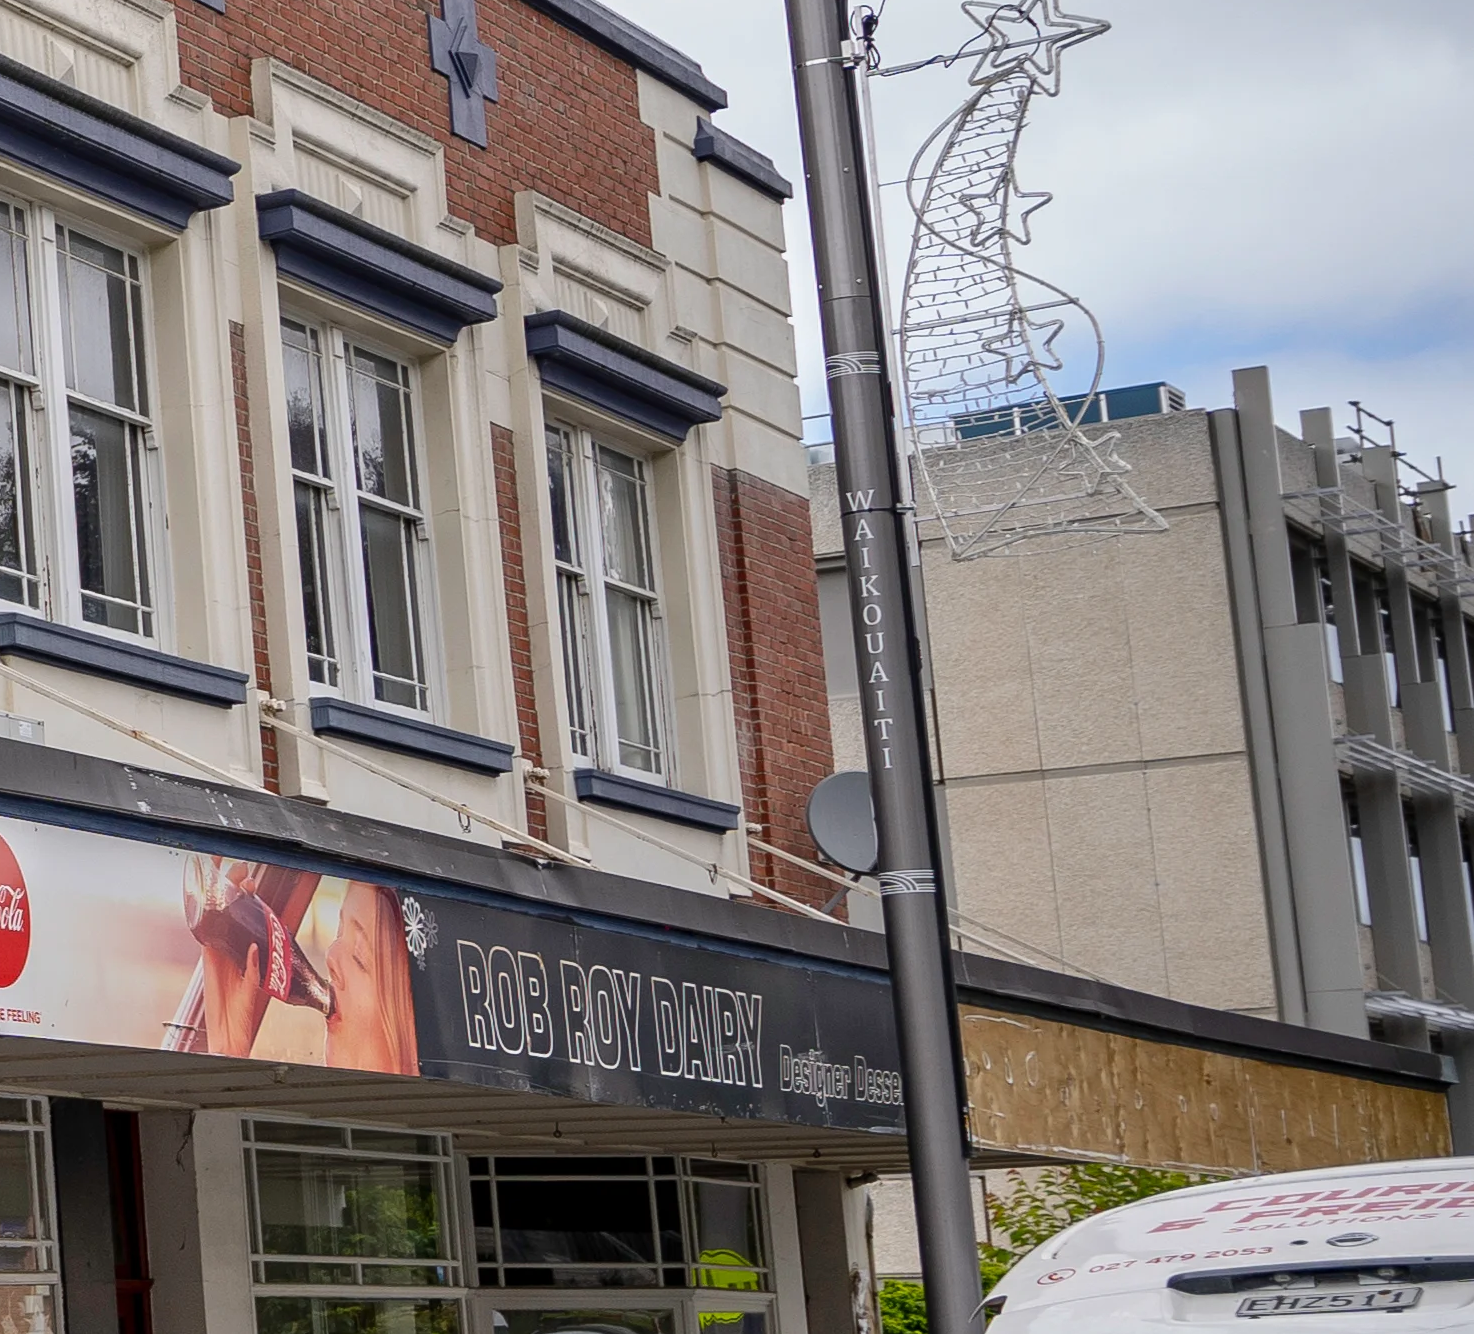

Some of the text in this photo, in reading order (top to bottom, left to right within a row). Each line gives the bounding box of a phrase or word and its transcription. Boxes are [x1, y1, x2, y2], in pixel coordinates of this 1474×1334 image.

[845, 489, 894, 770] WAIKOUAITI
[6, 1008, 41, 1024] FEELING
[456, 939, 763, 1088] ROB ROY DAIRY
[779, 1043, 851, 1107] Designer
[1222, 1213, 1433, 1234] SOLUTIONS
[1089, 1246, 1275, 1274] 027 479 2053
[1246, 1289, 1406, 1312] EHZ511
